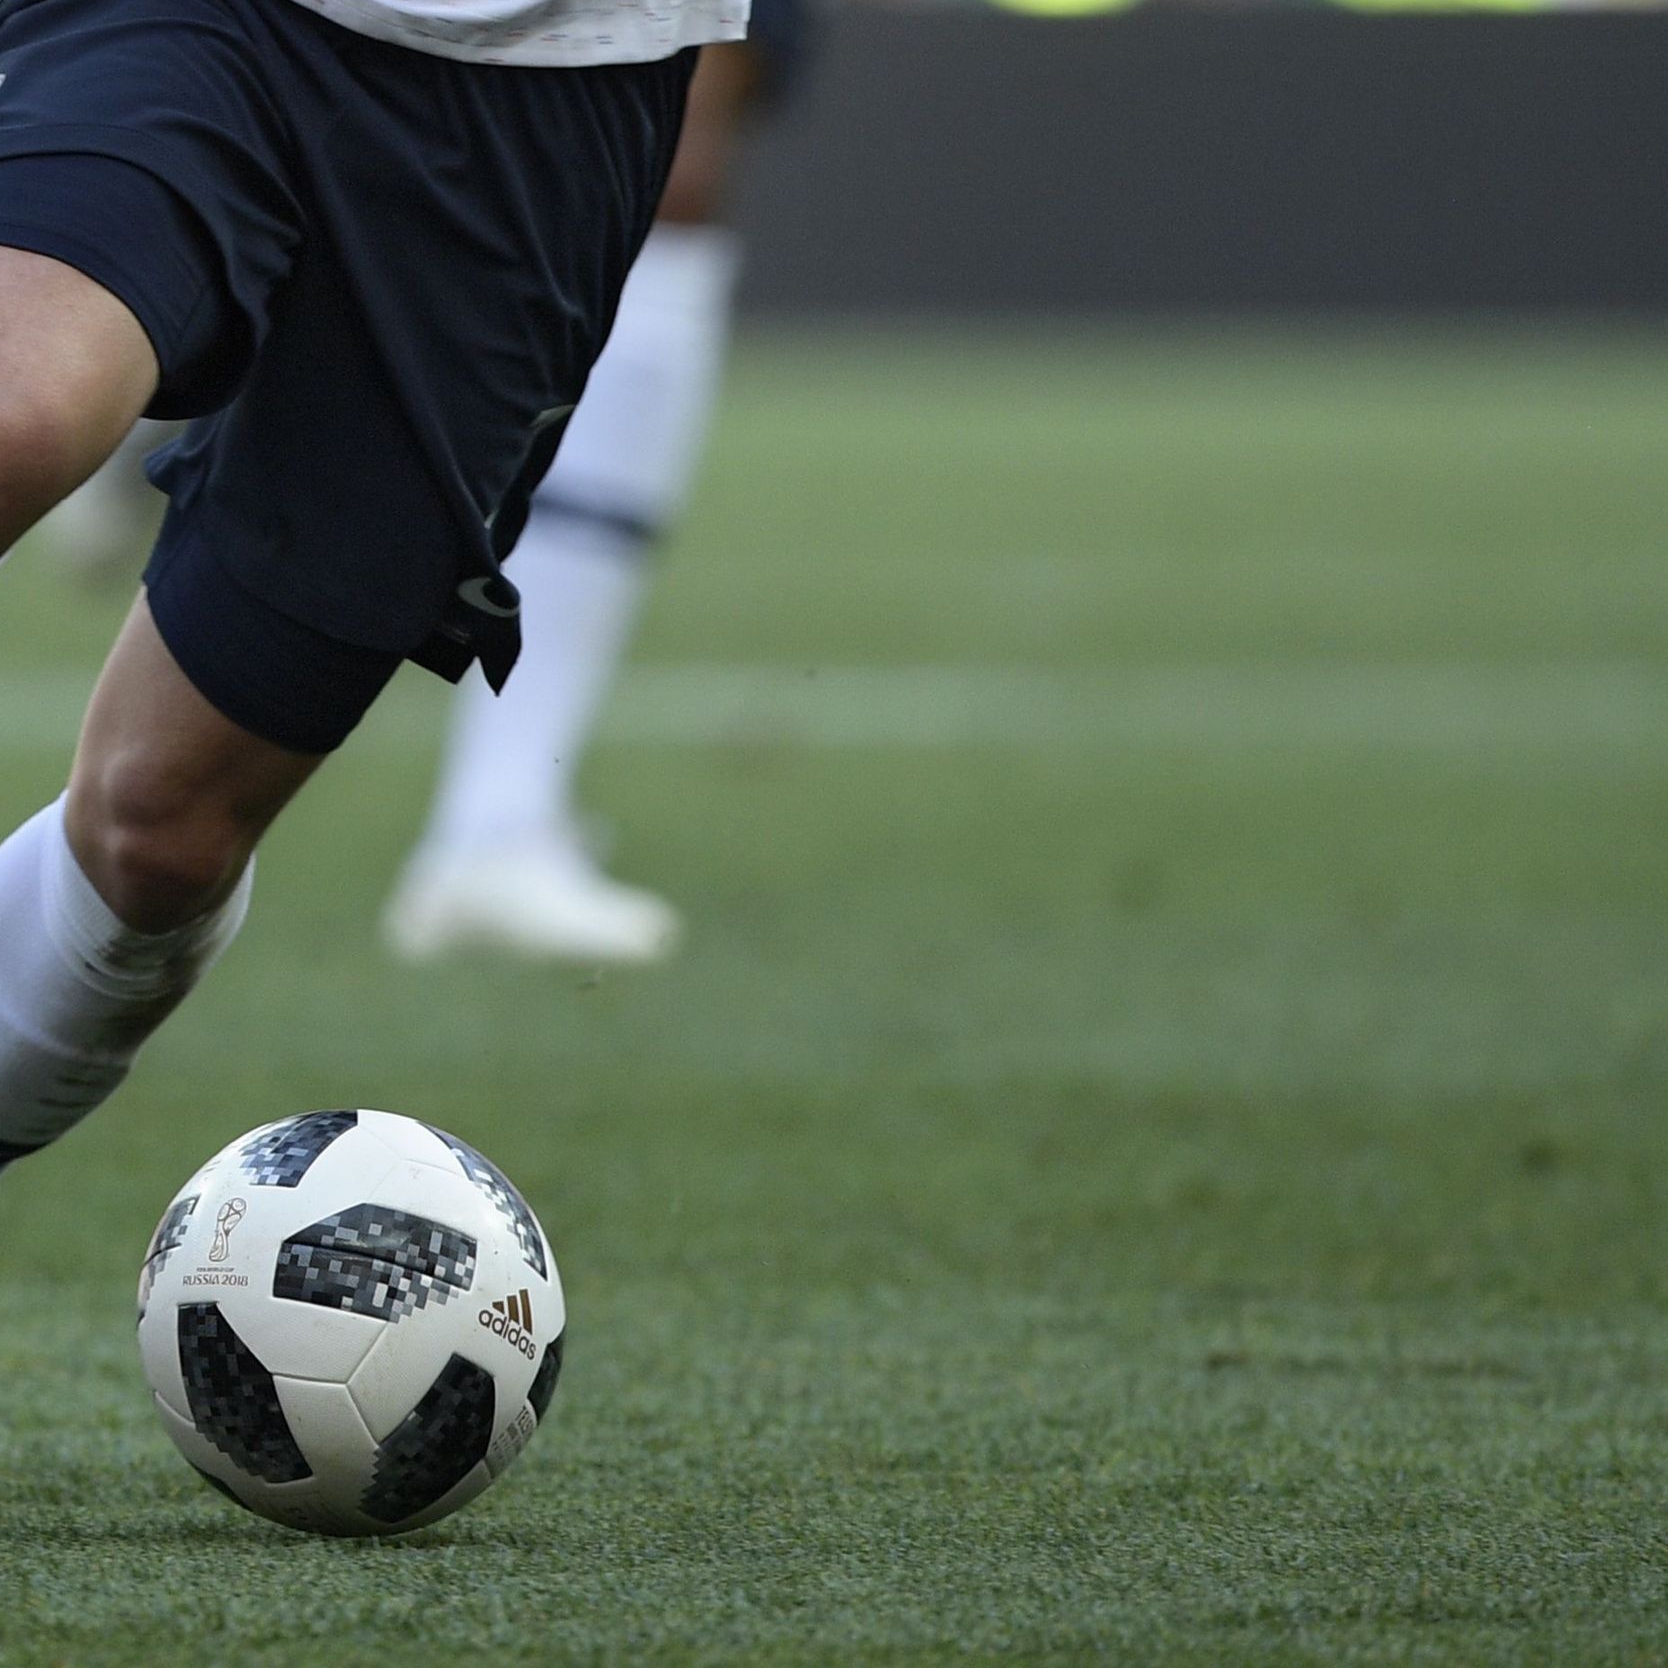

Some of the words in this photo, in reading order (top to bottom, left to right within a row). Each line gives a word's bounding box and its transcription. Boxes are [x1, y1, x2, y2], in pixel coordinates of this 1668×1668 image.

[183, 1273, 220, 1287] RUSSIA
[221, 1273, 249, 1287] 2018
[479, 1309, 536, 1360] adidas
